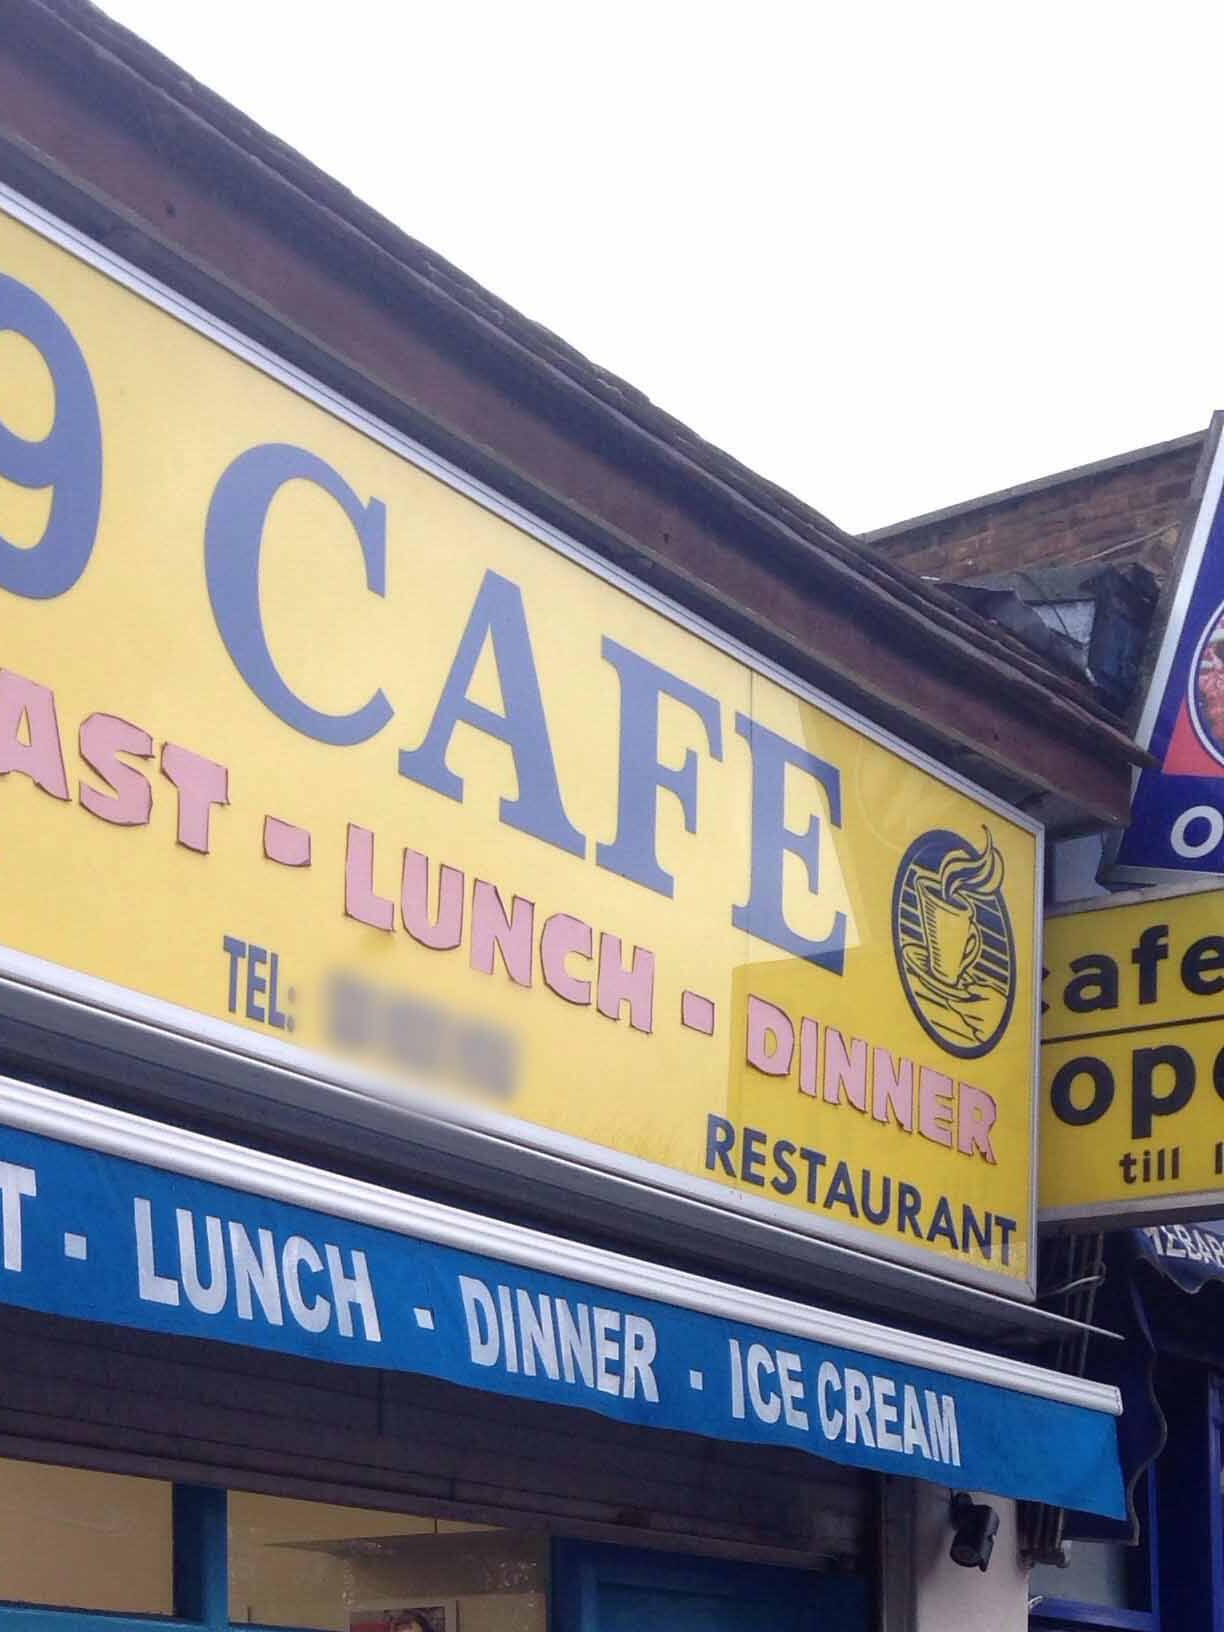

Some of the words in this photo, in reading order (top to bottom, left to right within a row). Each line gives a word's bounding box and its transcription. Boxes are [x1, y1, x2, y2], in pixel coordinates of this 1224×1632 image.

[204, 442, 848, 977] CAFE
[223, 935, 296, 1031] TEL:
[344, 823, 655, 1034] LUNCH
[747, 994, 997, 1164] DINNER
[1042, 925, 1224, 1014] afe
[1051, 1045, 1224, 1139] op
[706, 1113, 1015, 1267] RESTAURANT
[1119, 1147, 1179, 1184] till
[133, 1198, 381, 1342] LUNCH
[458, 1275, 659, 1403] DINNER
[729, 1338, 809, 1431] ICE
[817, 1360, 960, 1467] CREAM
